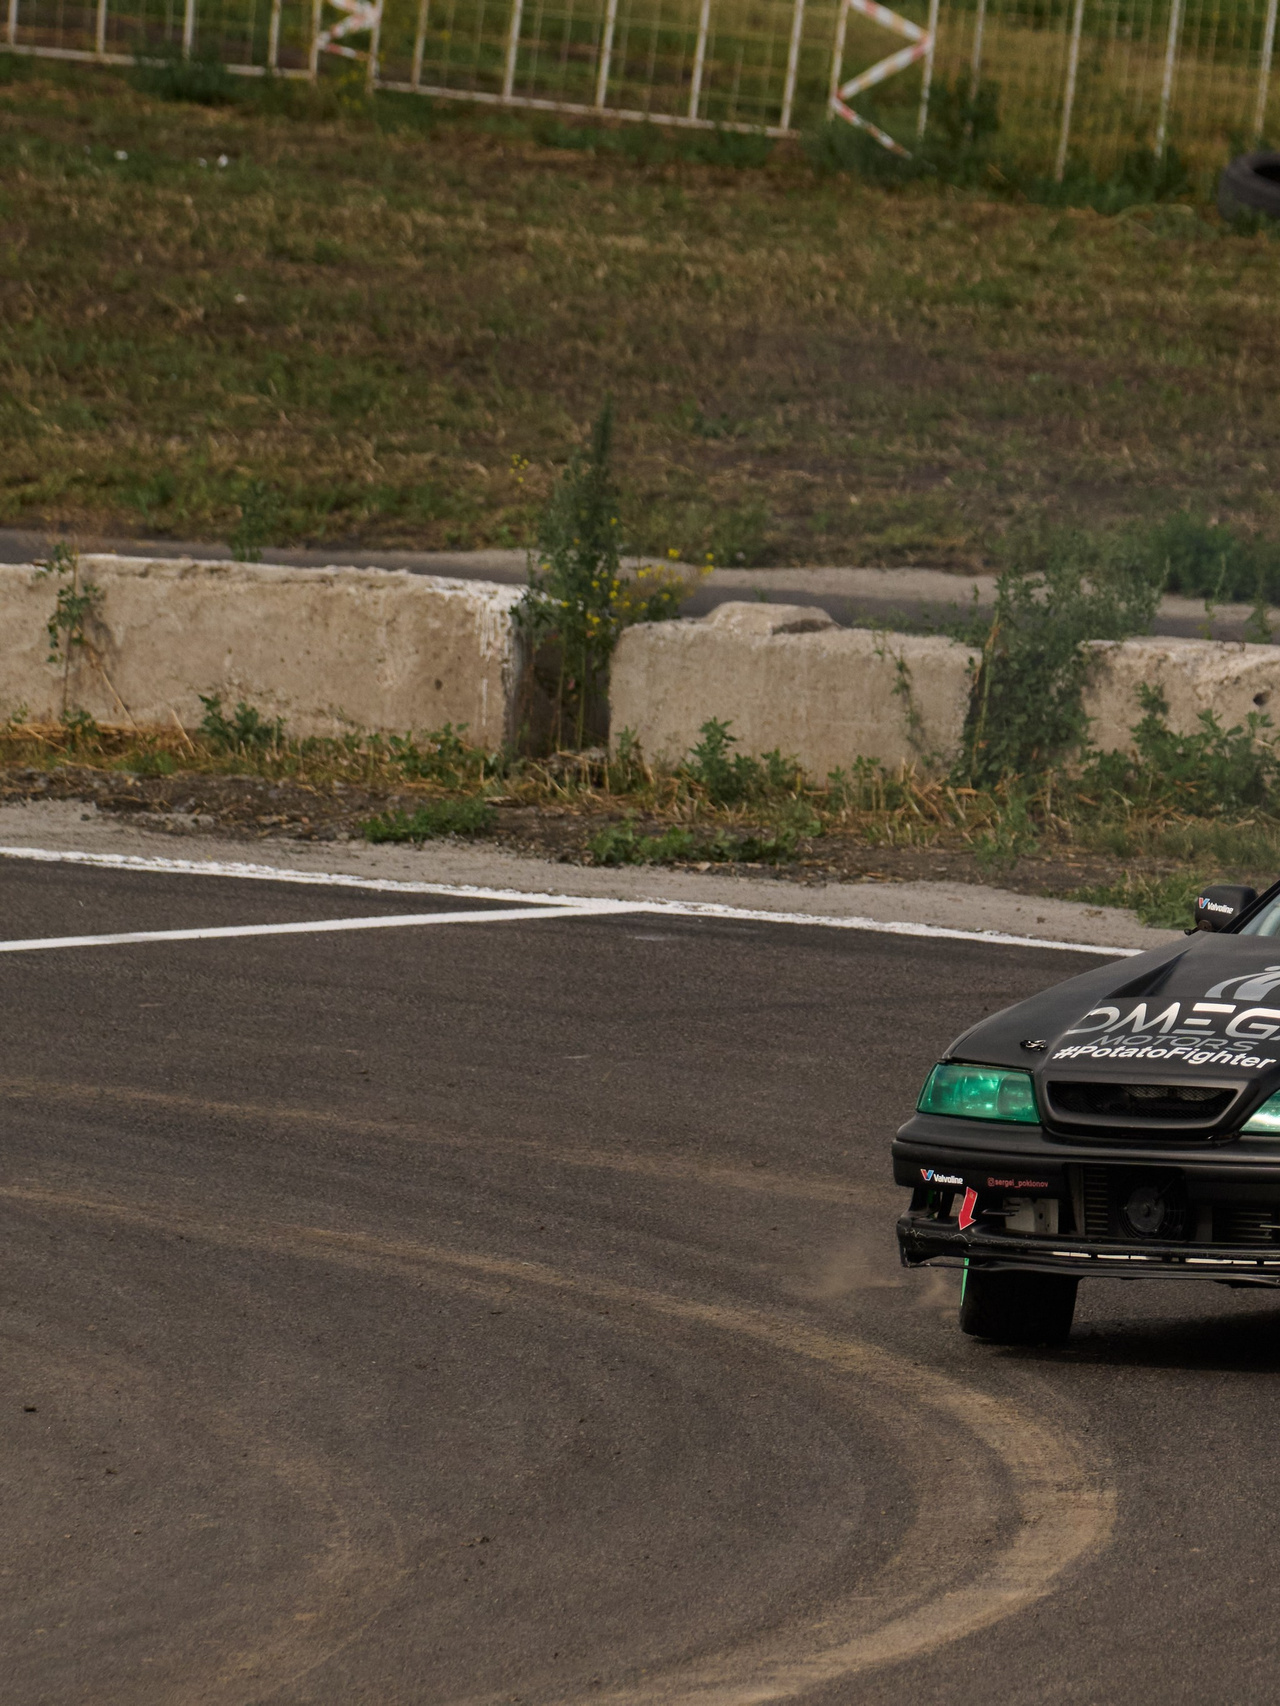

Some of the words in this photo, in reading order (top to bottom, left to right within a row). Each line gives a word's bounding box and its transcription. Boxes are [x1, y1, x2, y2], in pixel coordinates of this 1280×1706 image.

[1207, 902, 1234, 914] Valvoline
[1088, 1034, 1260, 1052] MOTORS
[1053, 1045, 1278, 1069] #PotatoFighter
[934, 1174, 963, 1184] Valvoline
